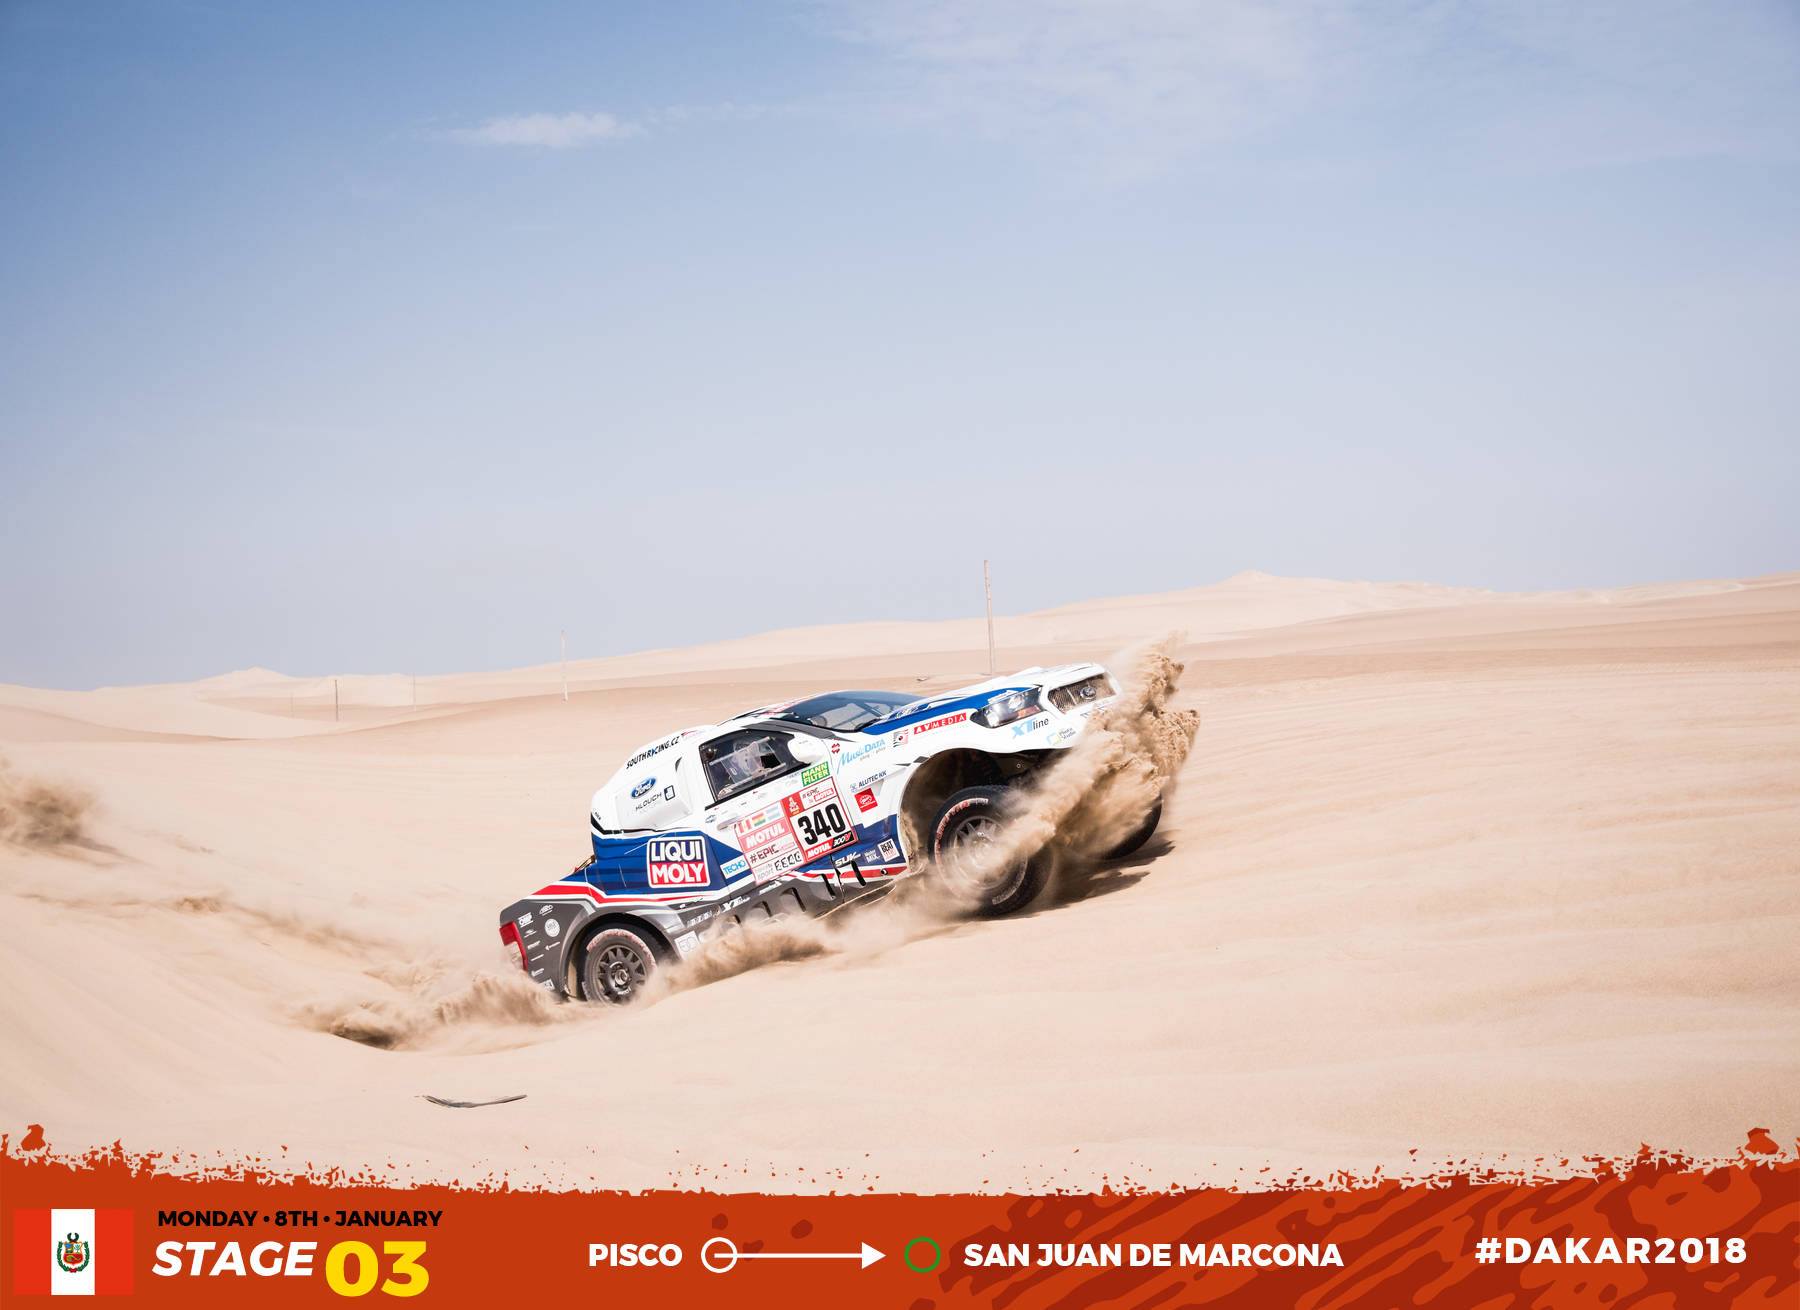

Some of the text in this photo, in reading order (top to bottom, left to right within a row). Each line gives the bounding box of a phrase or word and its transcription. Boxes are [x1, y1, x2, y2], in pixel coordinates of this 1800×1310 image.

[798, 803, 846, 845] 340
[746, 823, 786, 848] MOTUL
[650, 840, 702, 862] LIQUI
[750, 844, 779, 864] #EPIC
[807, 842, 833, 859] MOTUL
[651, 863, 704, 883] MOLY
